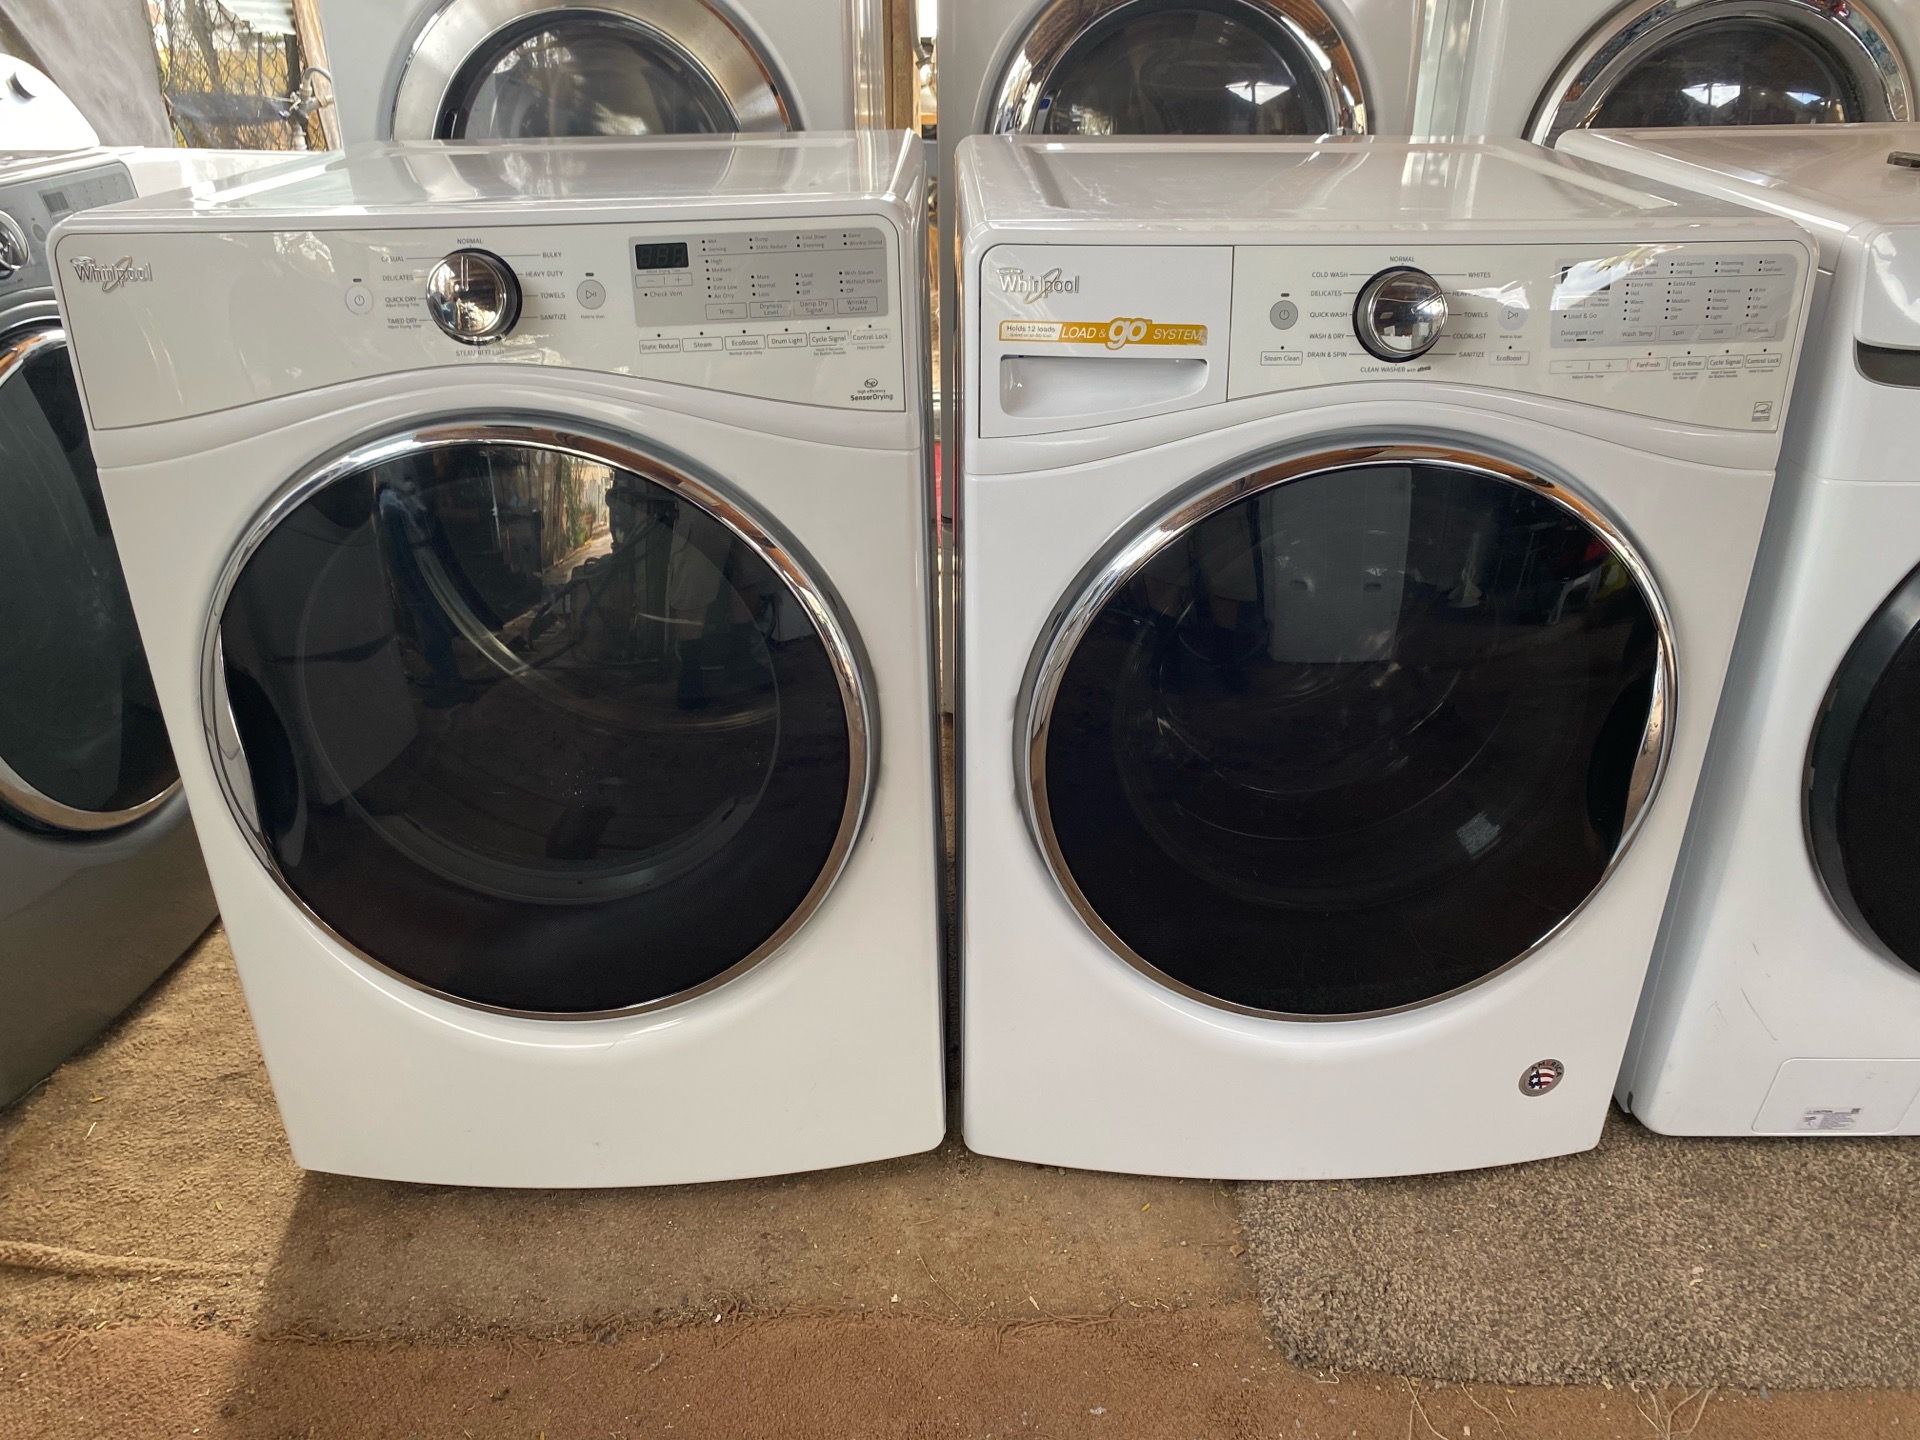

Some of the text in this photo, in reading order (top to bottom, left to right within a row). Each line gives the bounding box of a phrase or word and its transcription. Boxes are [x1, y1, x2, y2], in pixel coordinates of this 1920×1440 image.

[74, 262, 153, 288] Whirlpool
[999, 274, 1080, 299] Whirlpool
[1038, 325, 1056, 333] loads
[1062, 319, 1202, 349] LOAD & go SYSTEM
[788, 337, 803, 345] Light
[811, 335, 847, 344] Cycle Signal
[851, 393, 893, 401] SensorDrying
